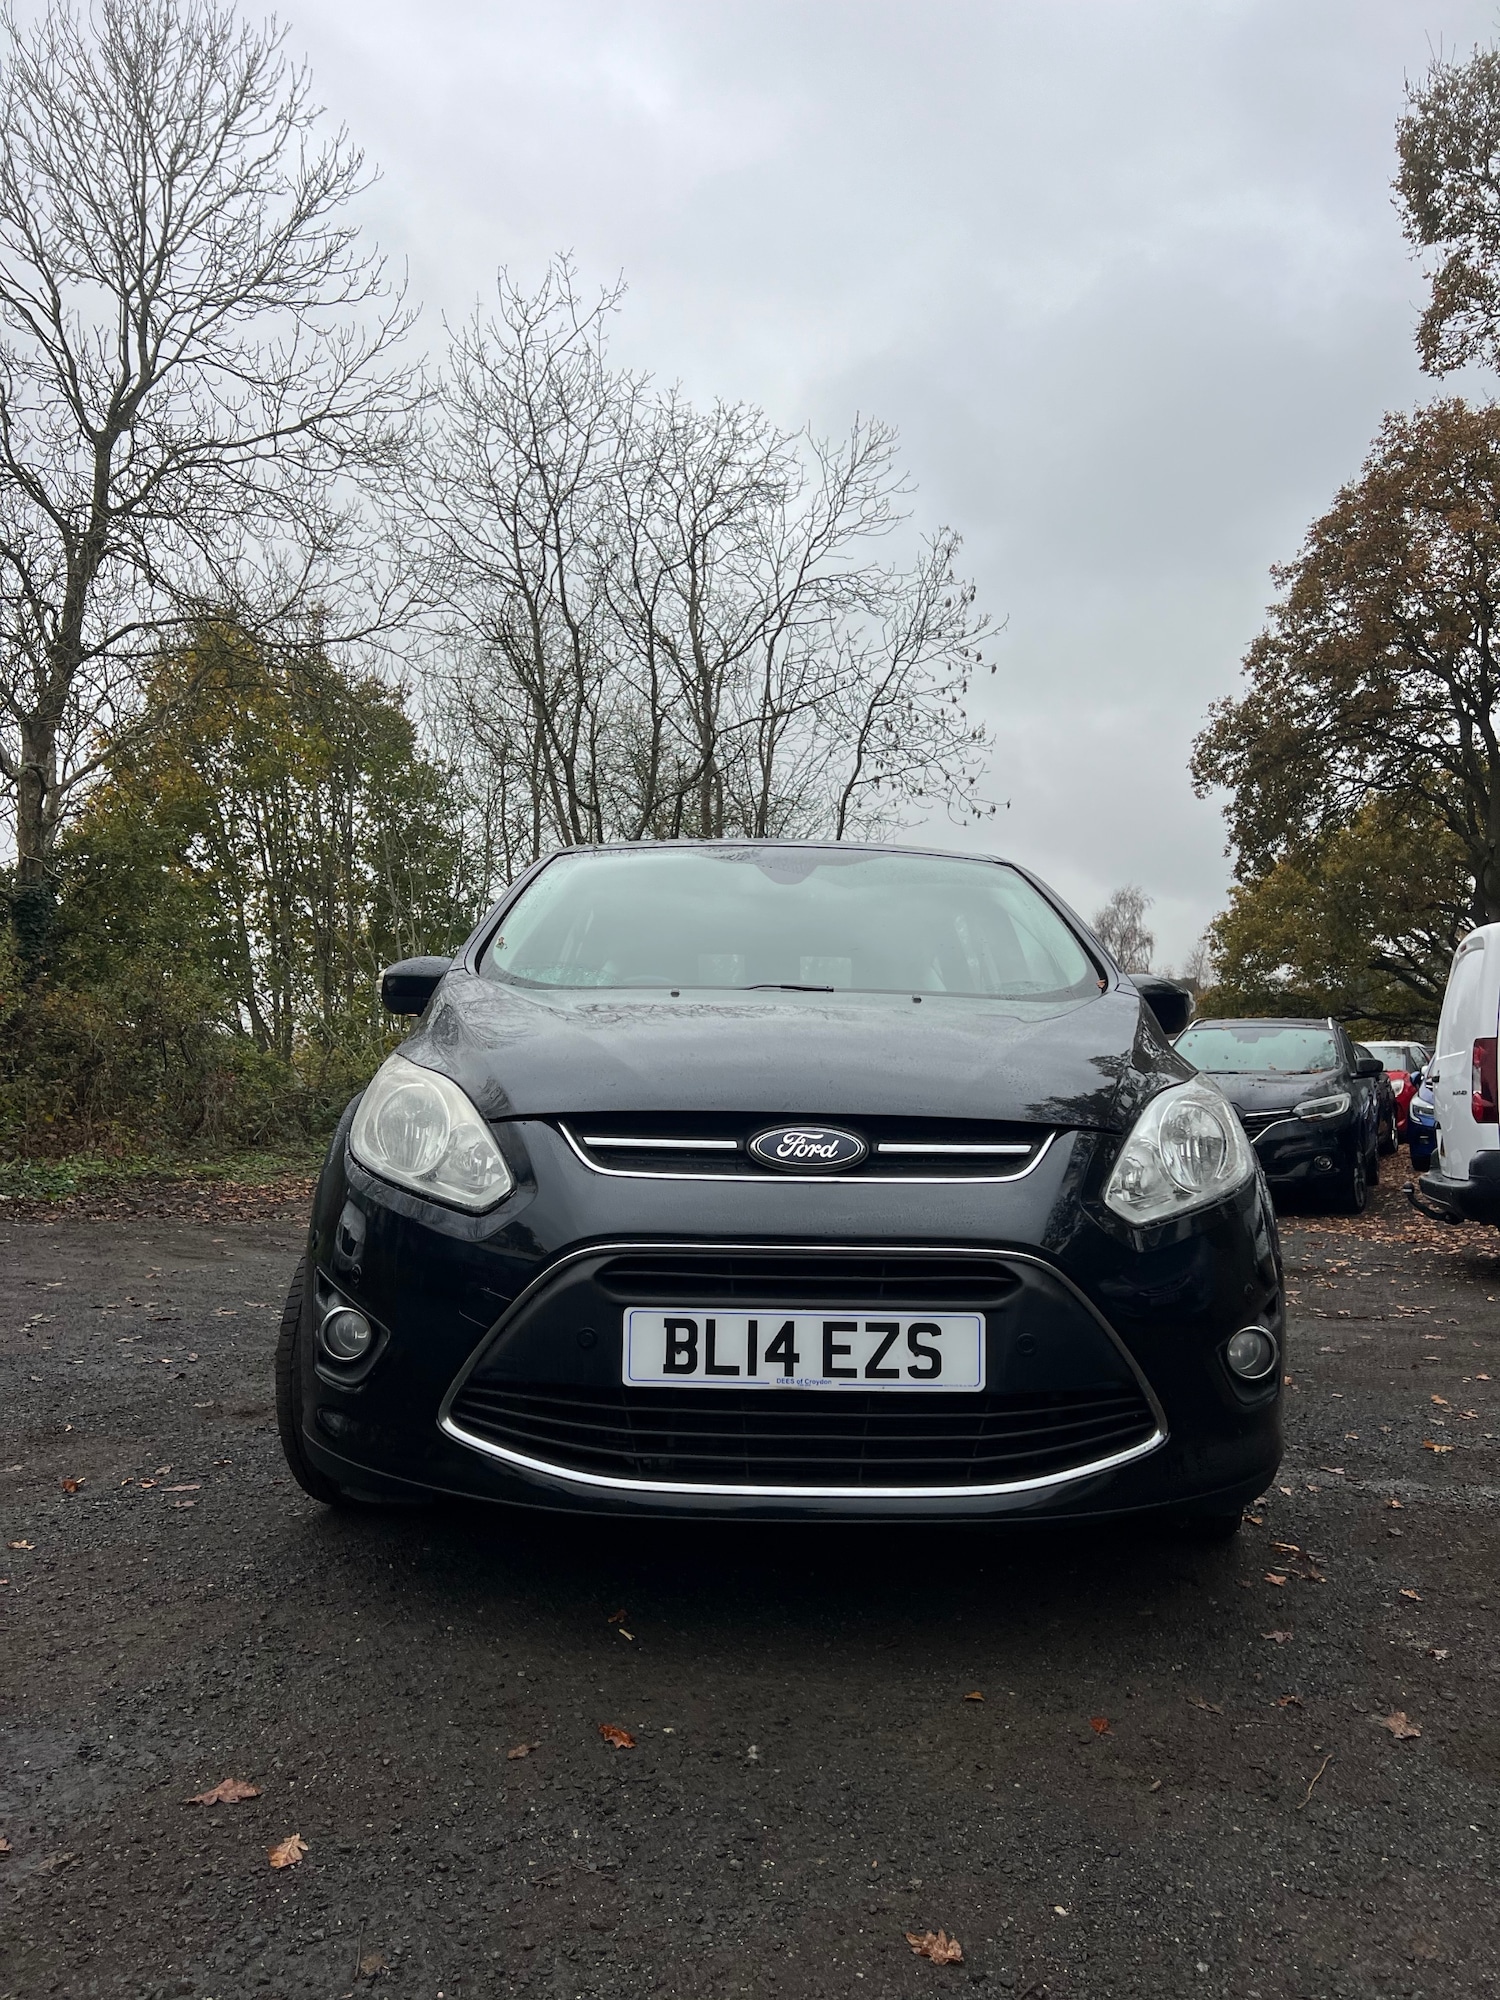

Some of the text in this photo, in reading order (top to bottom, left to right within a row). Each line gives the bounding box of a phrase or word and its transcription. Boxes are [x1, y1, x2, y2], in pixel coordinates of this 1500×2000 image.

[776, 1132, 839, 1158] Ford
[663, 1318, 942, 1379] BL14 EZS
[776, 1377, 795, 1385] DEES
[804, 1378, 832, 1386] Croydon
